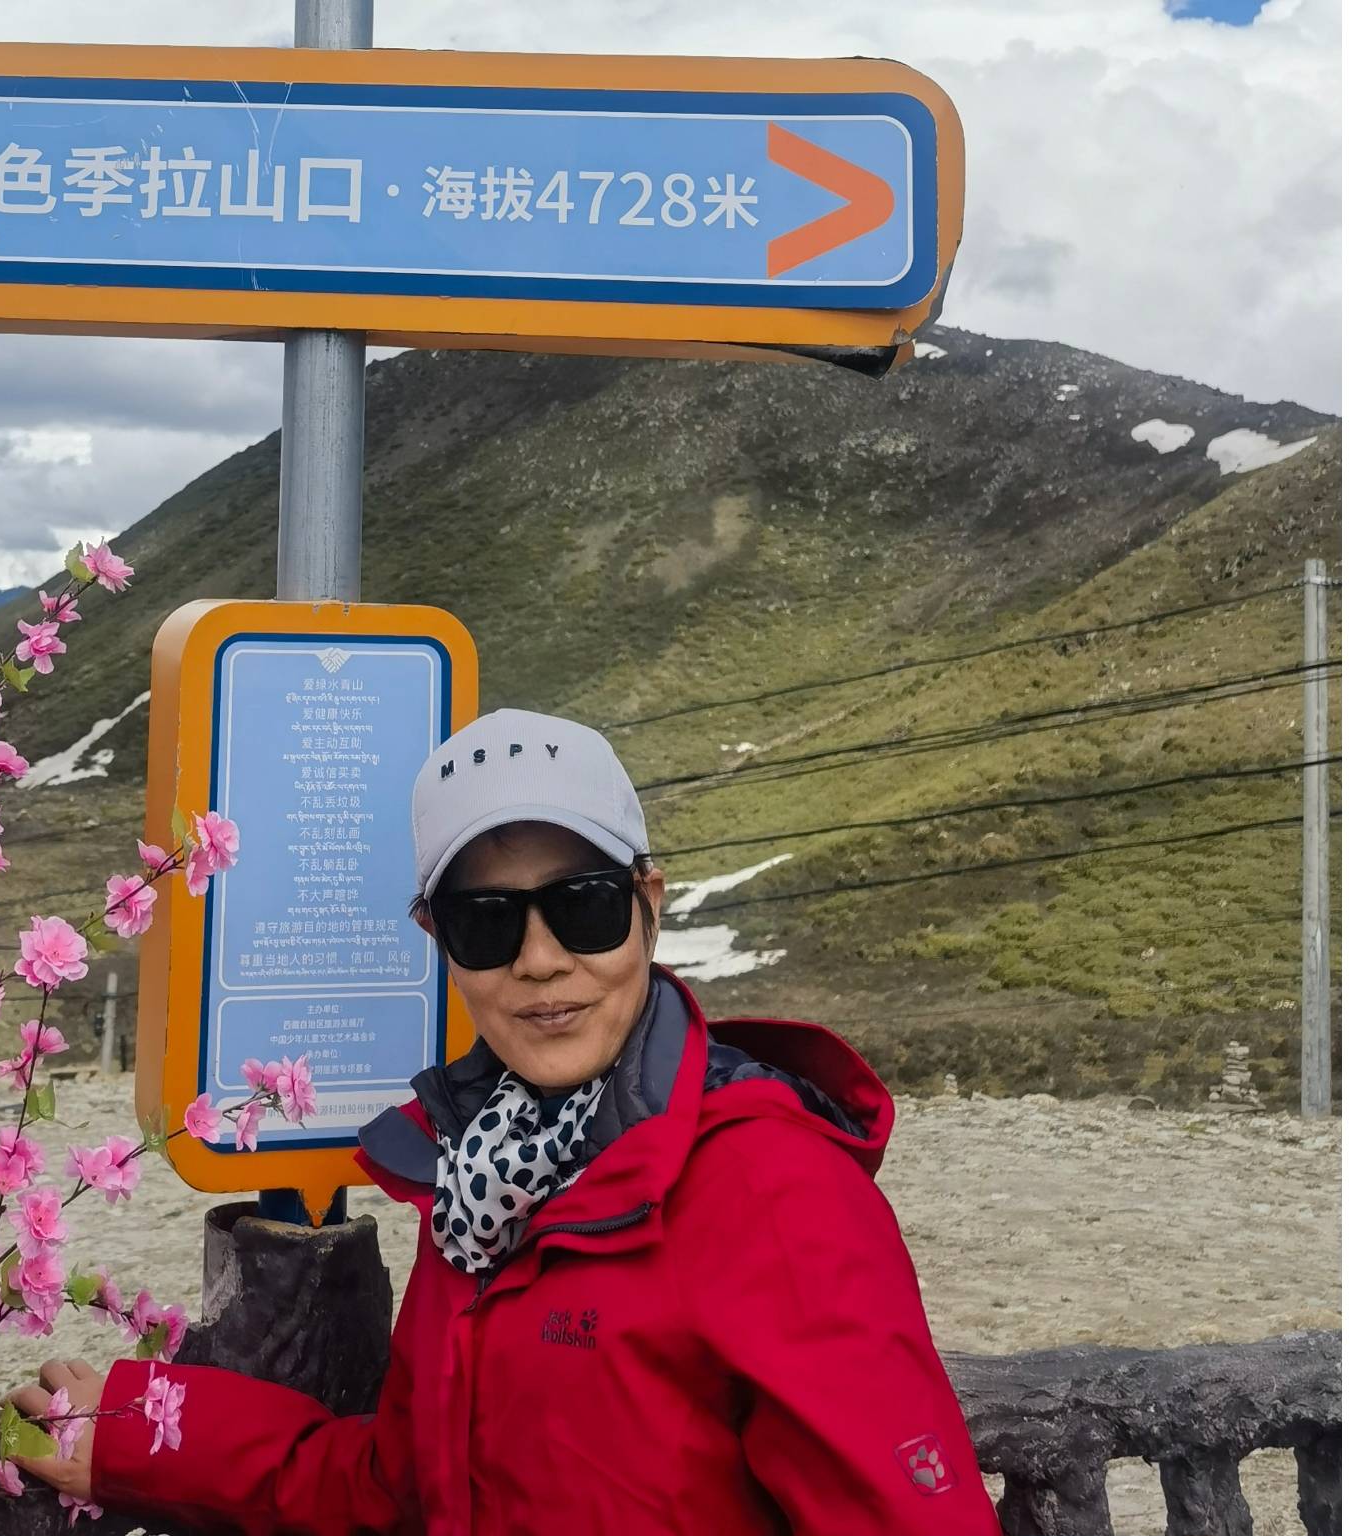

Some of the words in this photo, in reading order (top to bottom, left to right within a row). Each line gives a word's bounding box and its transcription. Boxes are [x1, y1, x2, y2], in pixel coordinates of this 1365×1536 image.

[302, 677, 364, 691] 爱绿水青山
[302, 707, 363, 721] 爱健康快乐
[301, 736, 362, 750] 爱主动互助
[440, 743, 559, 779] MSPY
[301, 766, 361, 779] 爱诚信买卖
[300, 796, 361, 809] 不乱丢垃圾
[300, 827, 360, 840] 不乱刻乱画
[298, 858, 359, 871] 不乱躺乱卧
[297, 889, 359, 902] 不大声喧哗
[254, 918, 398, 934] 遵守旅游目的地的管理规定
